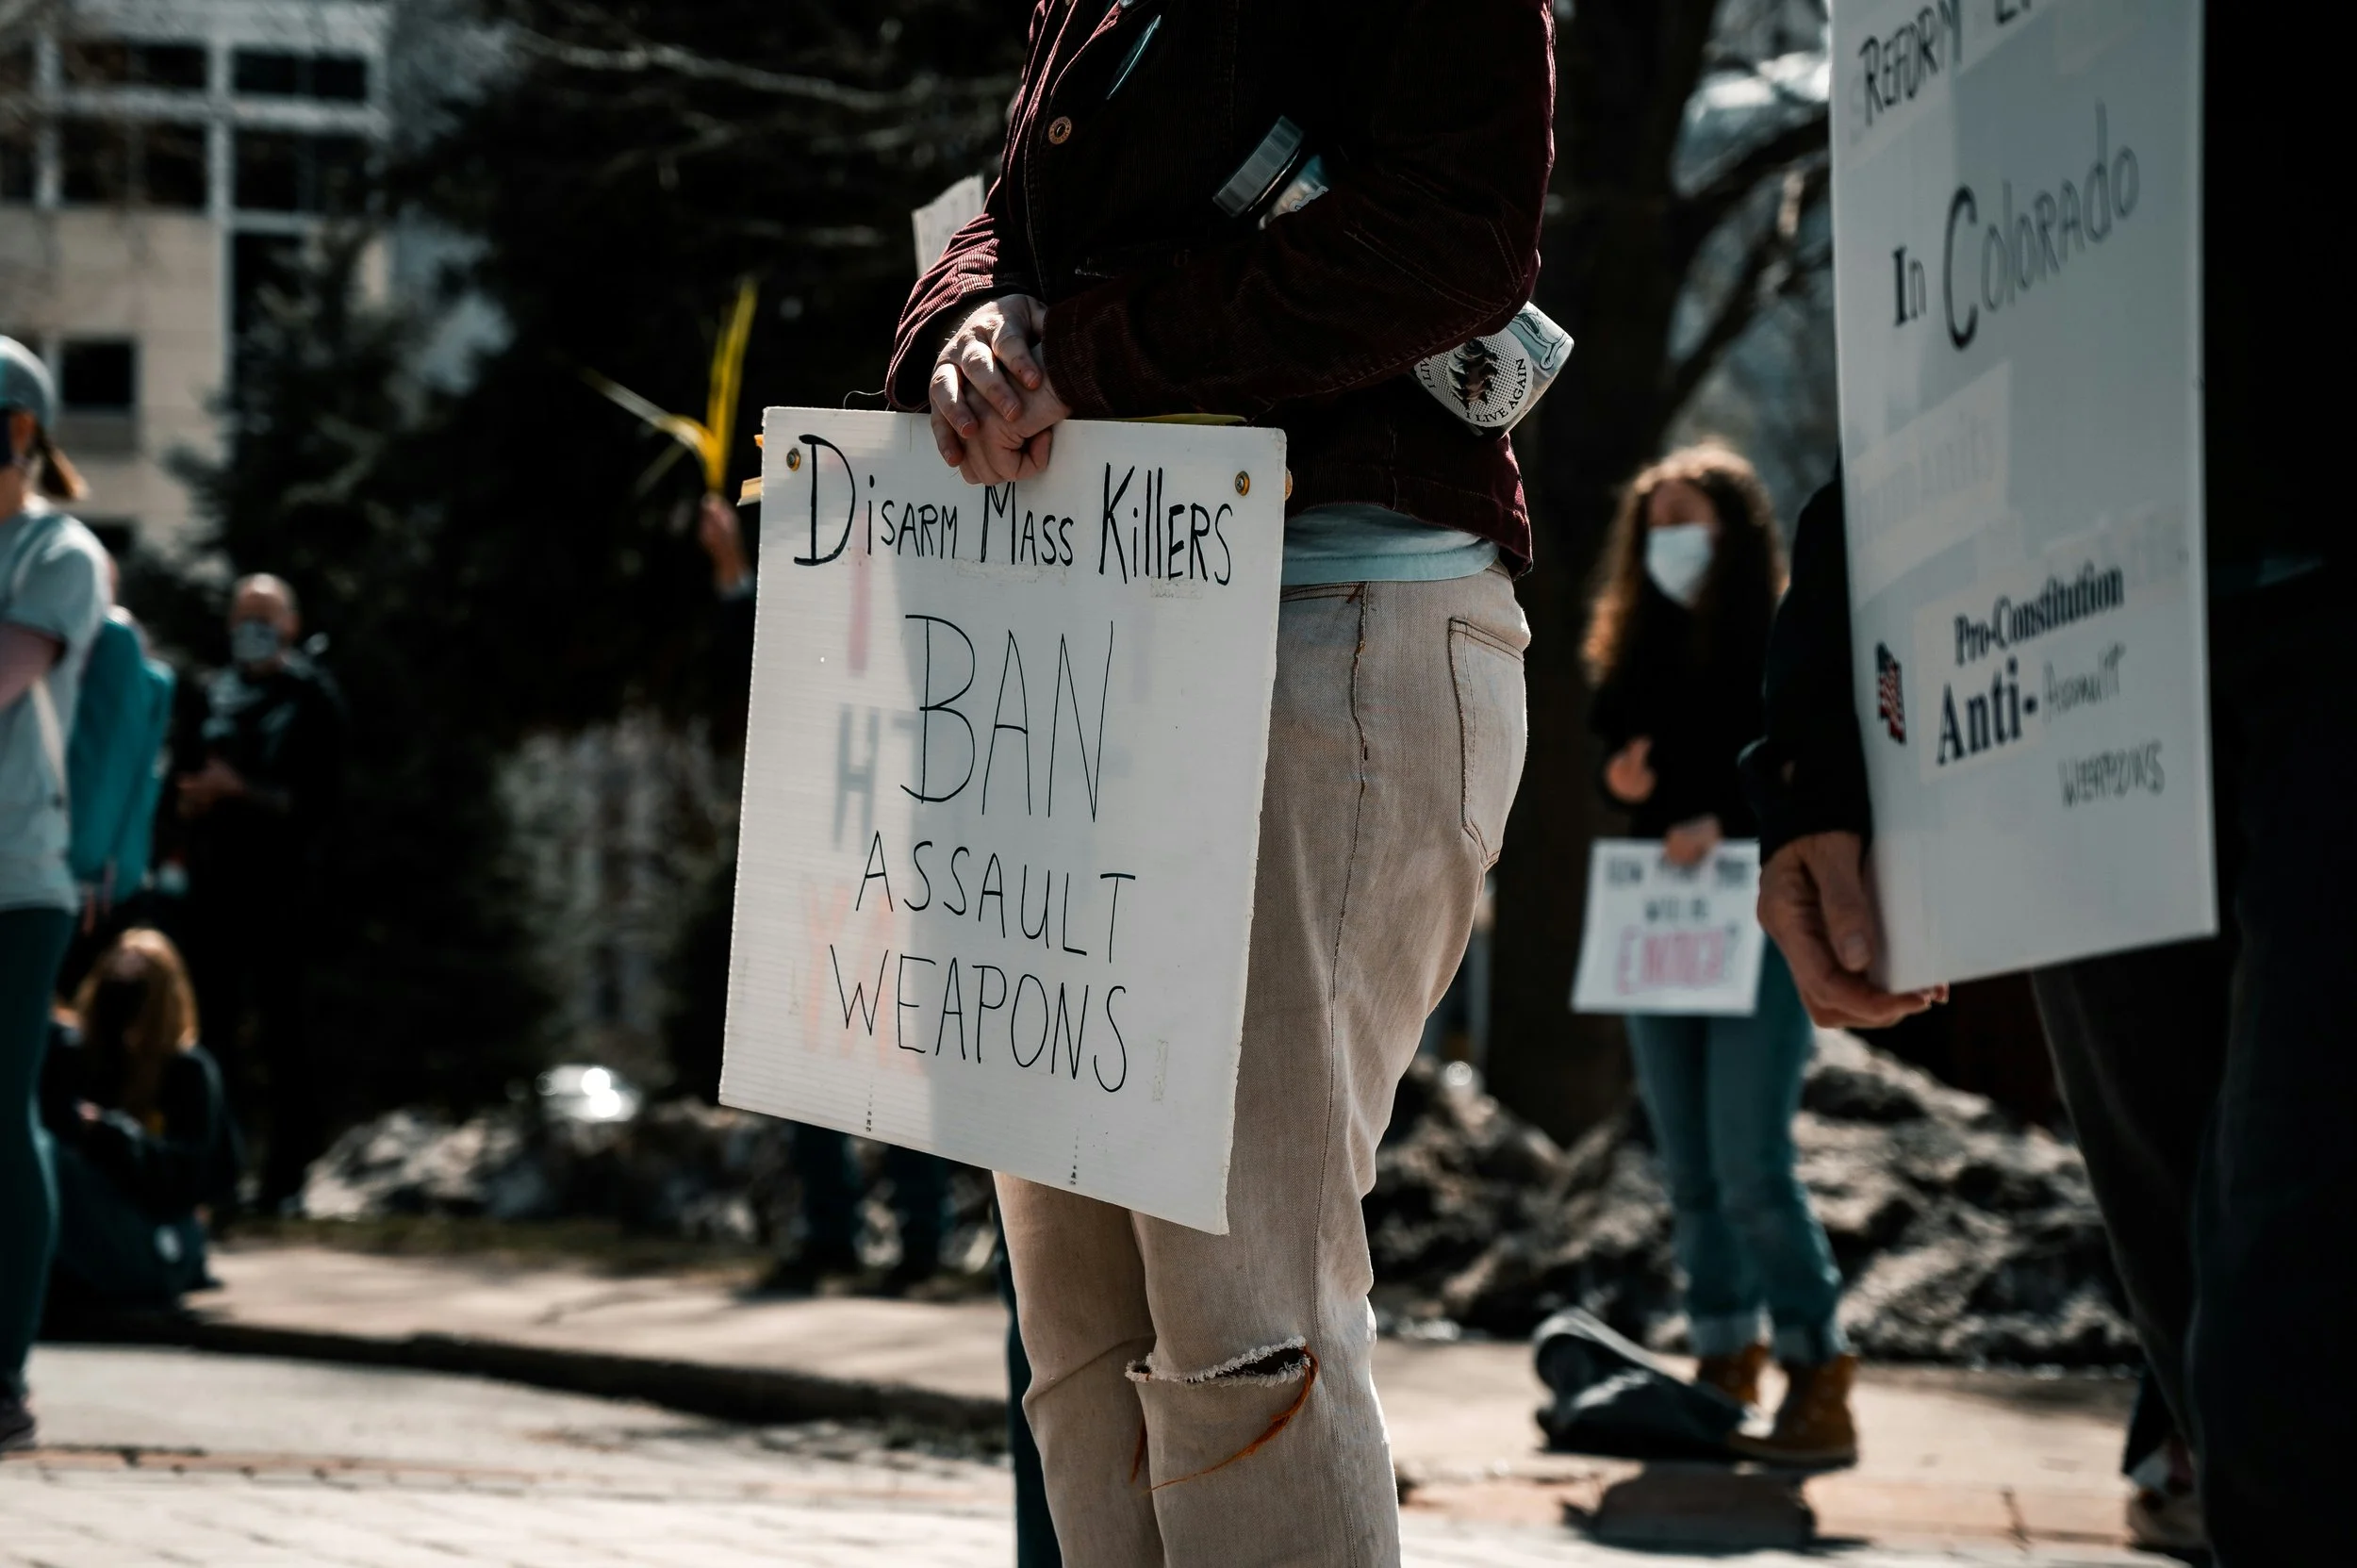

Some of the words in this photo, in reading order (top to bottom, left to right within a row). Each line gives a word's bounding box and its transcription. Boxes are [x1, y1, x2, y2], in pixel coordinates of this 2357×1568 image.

[1892, 244, 1927, 327] In
[1476, 406, 1508, 422] LIVE
[1508, 357, 1527, 410] AGAIN
[1954, 560, 2125, 666] Pro-Constitution
[901, 615, 1114, 822] BAN
[1937, 657, 2037, 767] Anti-
[856, 831, 1136, 964] ASSAULT
[831, 944, 1128, 1093] WEAPONS
